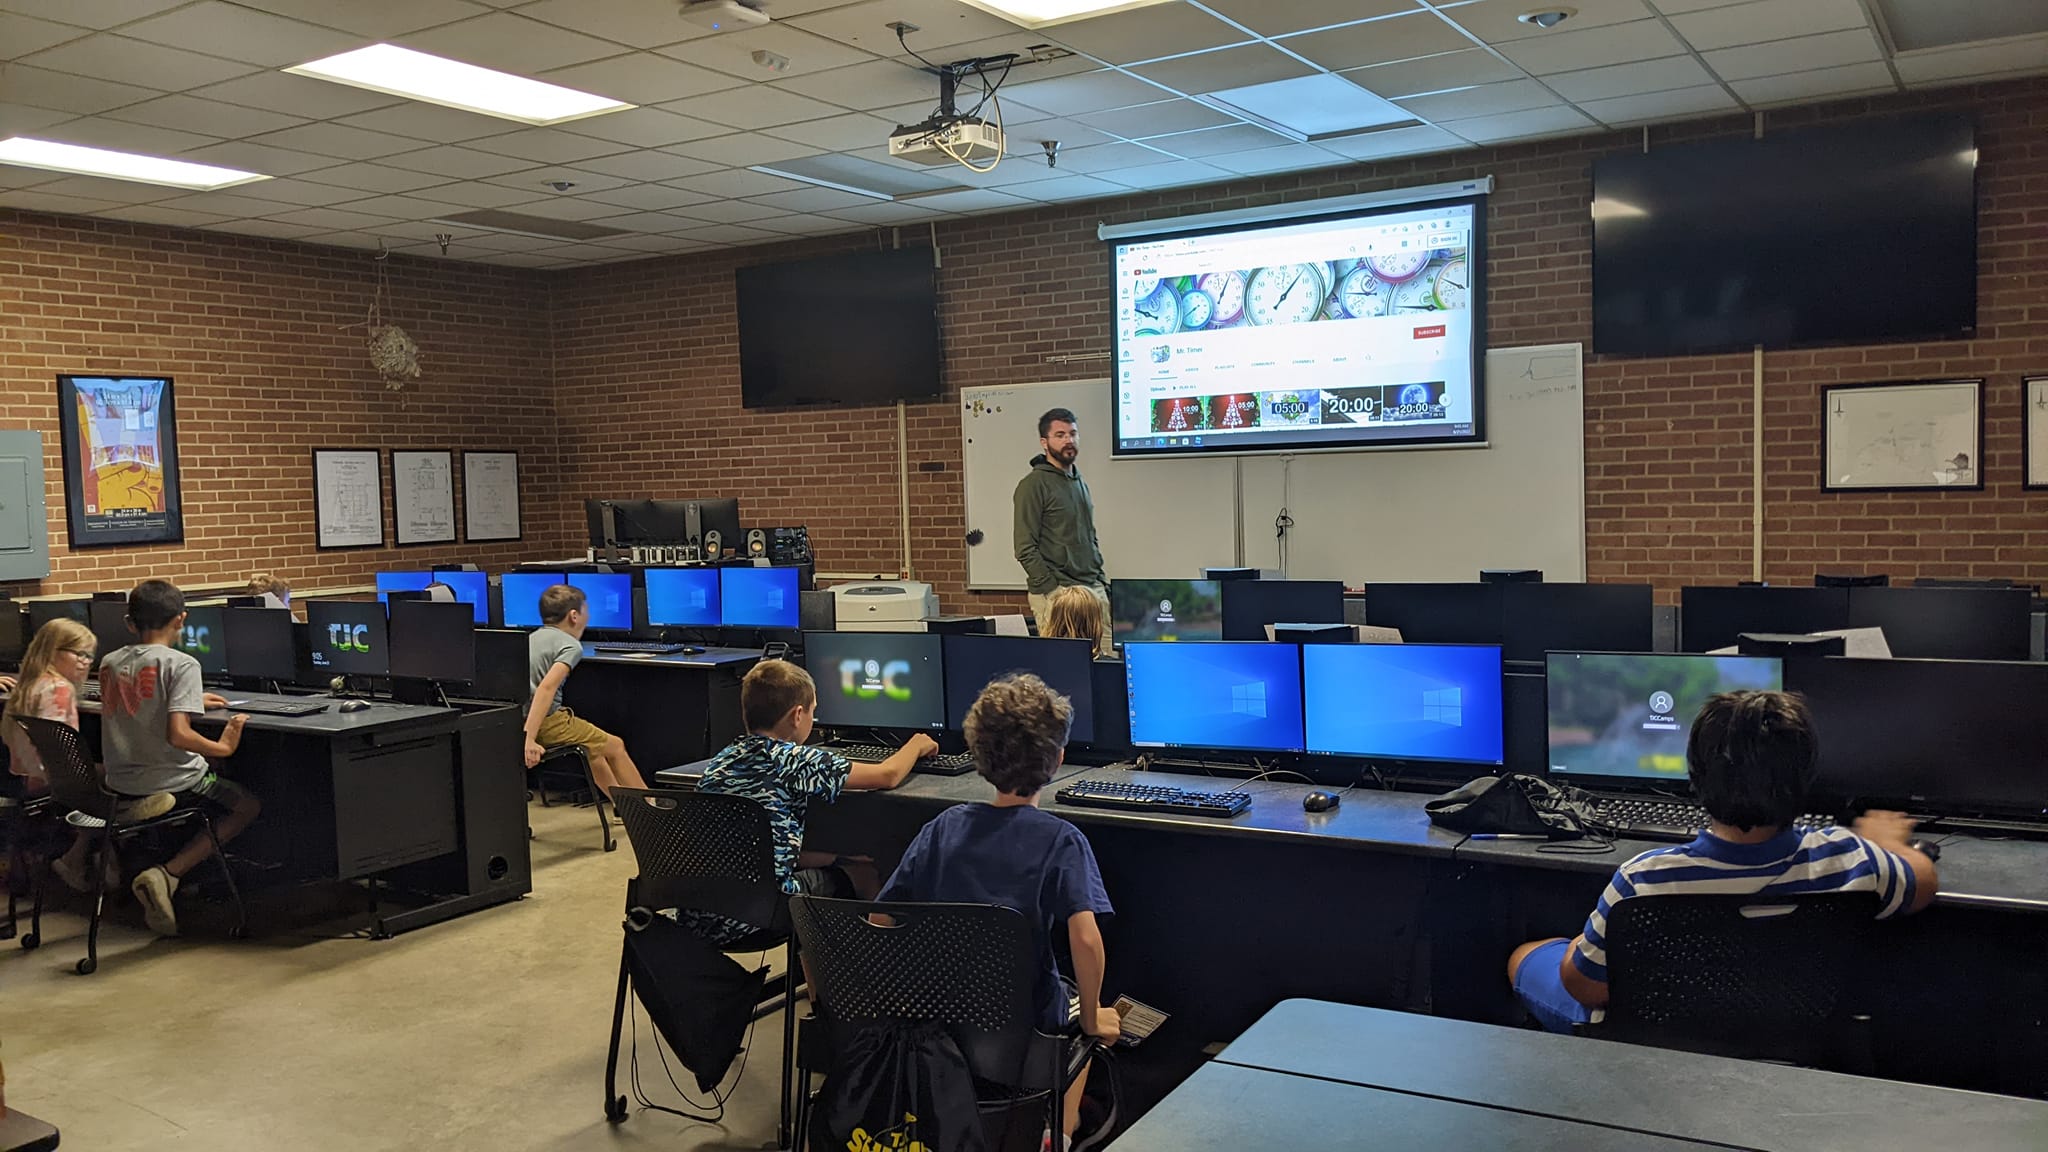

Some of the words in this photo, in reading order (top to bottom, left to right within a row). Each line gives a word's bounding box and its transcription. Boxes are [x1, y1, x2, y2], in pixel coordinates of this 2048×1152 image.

[1274, 402, 1306, 414] 05:00
[1328, 397, 1374, 414] 20:00
[1399, 402, 1429, 414] 20:00
[328, 623, 370, 653] TJC
